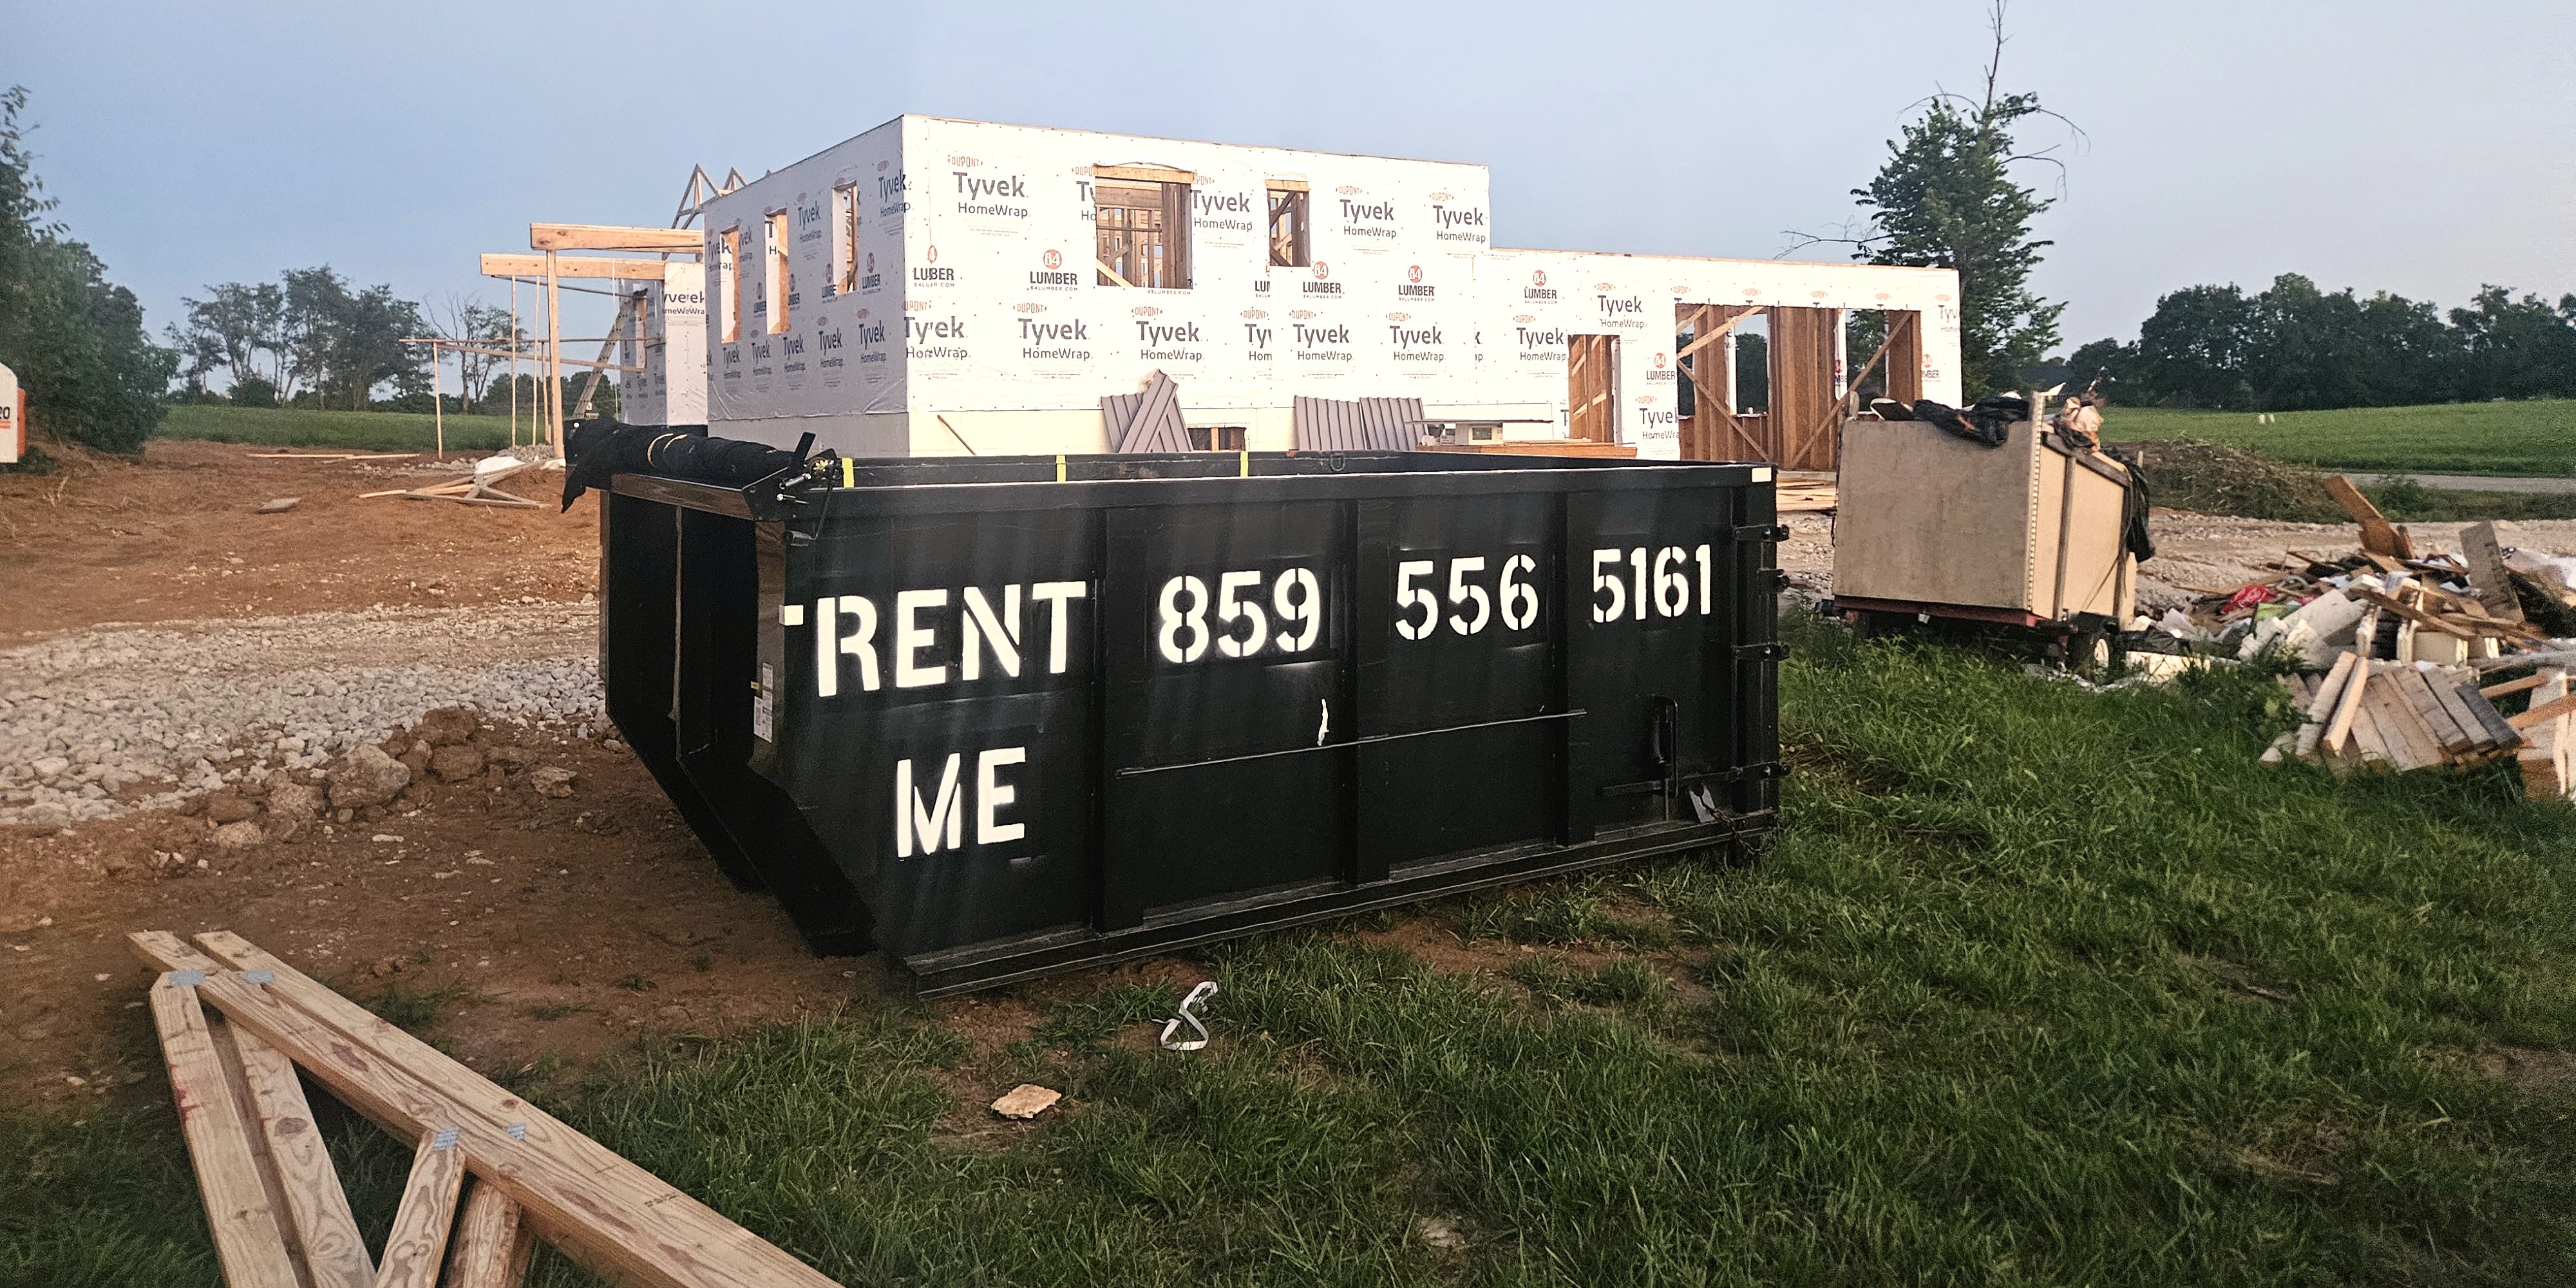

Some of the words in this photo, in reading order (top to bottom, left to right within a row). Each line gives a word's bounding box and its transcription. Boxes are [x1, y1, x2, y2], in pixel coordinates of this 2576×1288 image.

[878, 169, 907, 203] Tyvek
[953, 172, 1025, 200] Tyvek
[958, 202, 1027, 219] HomeWrap
[1189, 189, 1250, 215] Tyvek
[1340, 199, 1394, 223] Tyvek
[797, 200, 820, 230] Tyvek
[1433, 205, 1483, 229] Tyvek
[1194, 218, 1252, 232] HomeWrap
[1344, 226, 1396, 239] HomeWrap
[1437, 231, 1486, 243] HomeWrap
[1044, 251, 1061, 267] 84
[1030, 271, 1077, 285] LUMBER
[1314, 265, 1328, 276] 84
[1409, 268, 1421, 280] 84
[1303, 281, 1341, 293] LUMBER
[1398, 285, 1434, 296] LUMBER
[1524, 289, 1557, 299] LUMBER
[1598, 295, 1642, 316] Tyvek
[1018, 318, 1087, 345] Tyvek
[1136, 321, 1199, 346] Tyvek
[1600, 319, 1644, 329] HomeWrap
[819, 327, 842, 355] Tyvek
[859, 320, 885, 350] Tyvek
[1293, 324, 1349, 348] Tyvek
[1389, 325, 1442, 349] Tyvek
[1517, 327, 1564, 349] Tyvek
[752, 339, 771, 365] Tyvek
[783, 334, 804, 361] Tyvek
[1023, 348, 1090, 361] HomeWrap
[1141, 349, 1202, 362] HomeWrap
[1298, 351, 1352, 362] HomeWrap
[1520, 352, 1566, 362] HomeWrap
[1394, 352, 1444, 363] HomeWrap
[1646, 370, 1676, 380] LUMBER
[817, 581, 1086, 697] RENT
[1160, 568, 1320, 663] 859
[1396, 554, 1539, 641] 556
[1593, 544, 1711, 623] 5161
[897, 746, 1025, 858] ME
